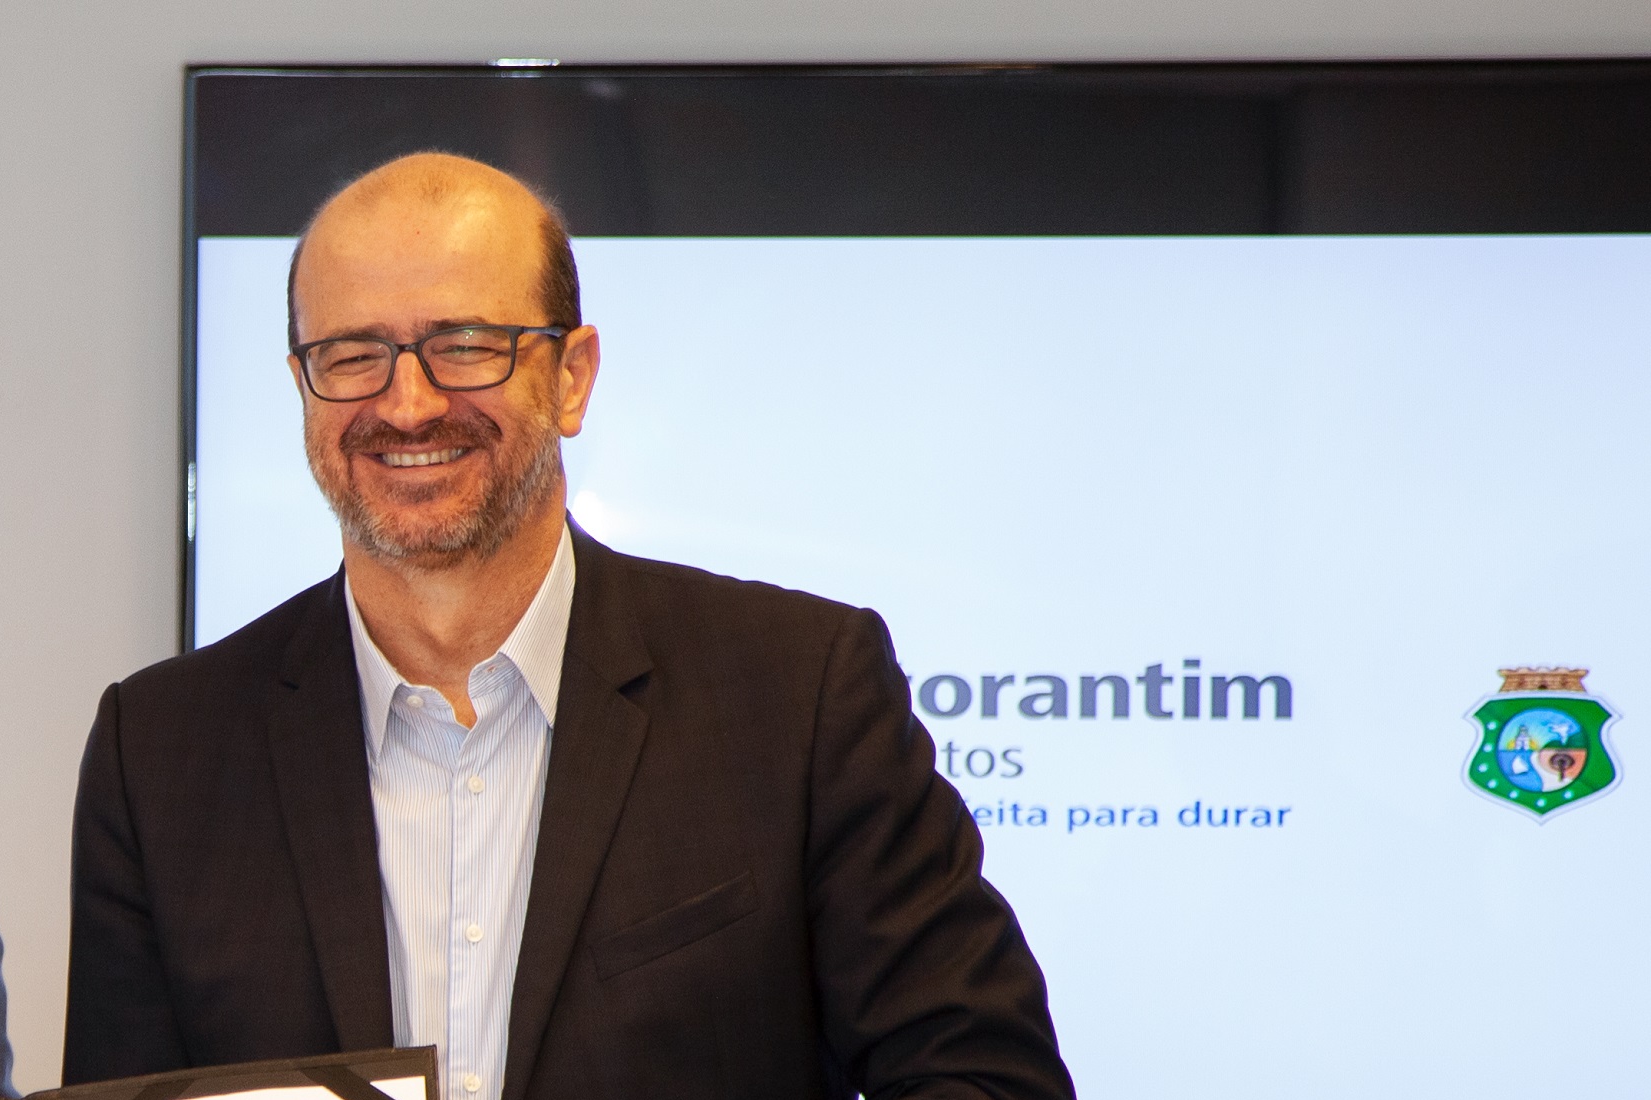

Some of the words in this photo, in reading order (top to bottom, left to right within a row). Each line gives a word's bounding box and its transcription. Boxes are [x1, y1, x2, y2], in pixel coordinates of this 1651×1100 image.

[898, 658, 1293, 720] orantim
[965, 799, 1048, 827] eita
[1067, 806, 1159, 834] para
[1178, 800, 1293, 828] durar
